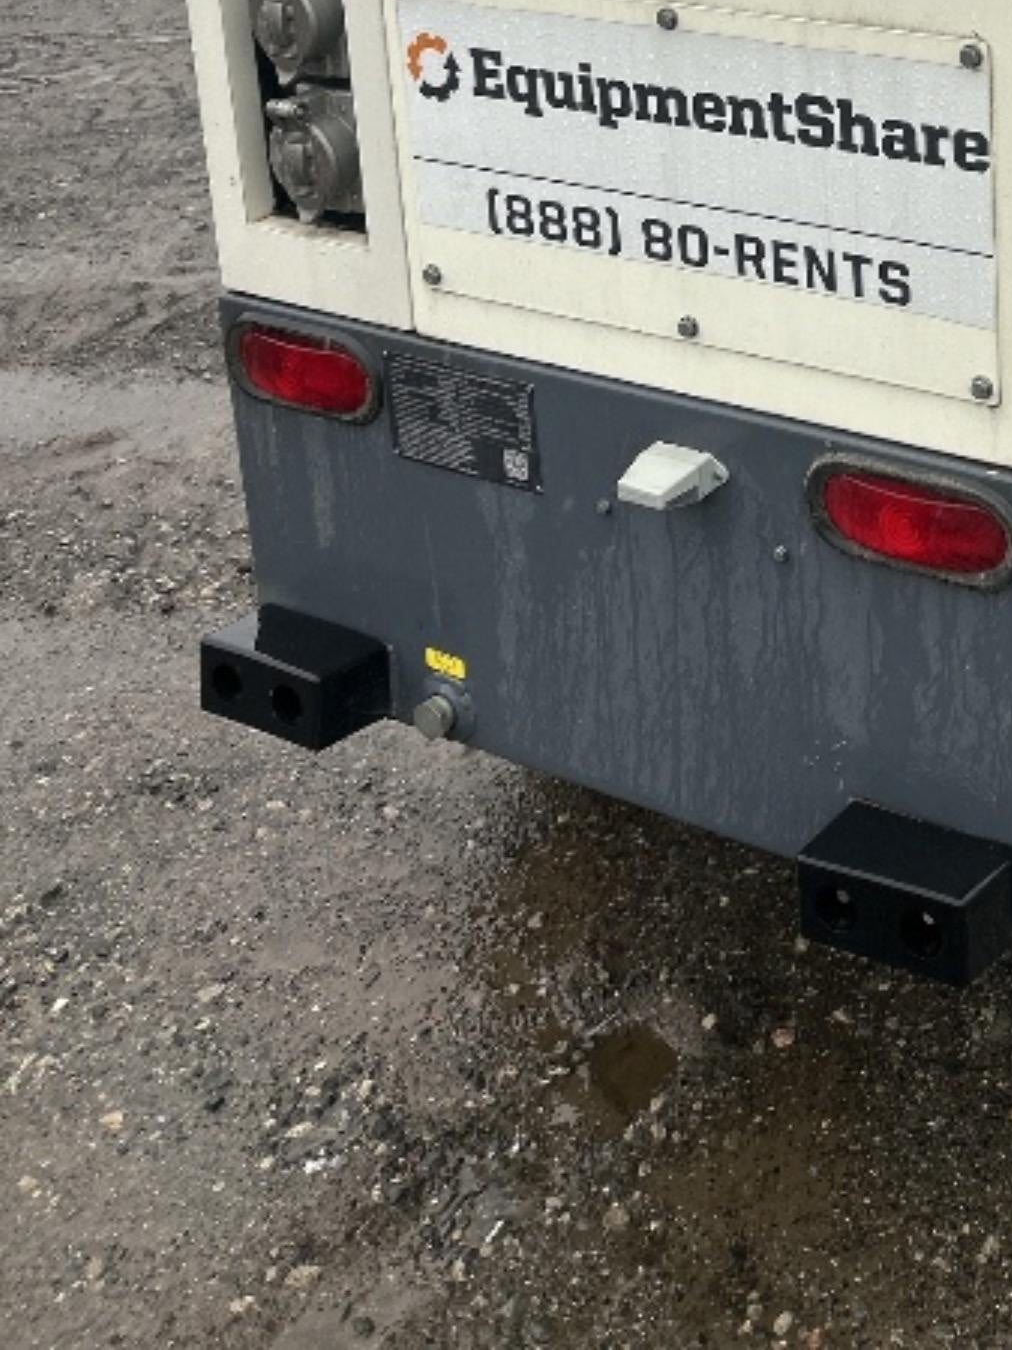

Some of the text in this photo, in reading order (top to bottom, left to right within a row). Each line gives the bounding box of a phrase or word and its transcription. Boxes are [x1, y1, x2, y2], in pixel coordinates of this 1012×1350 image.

[467, 46, 991, 174] EquipmentShare
[486, 186, 912, 307] (888) 80-RENTS
